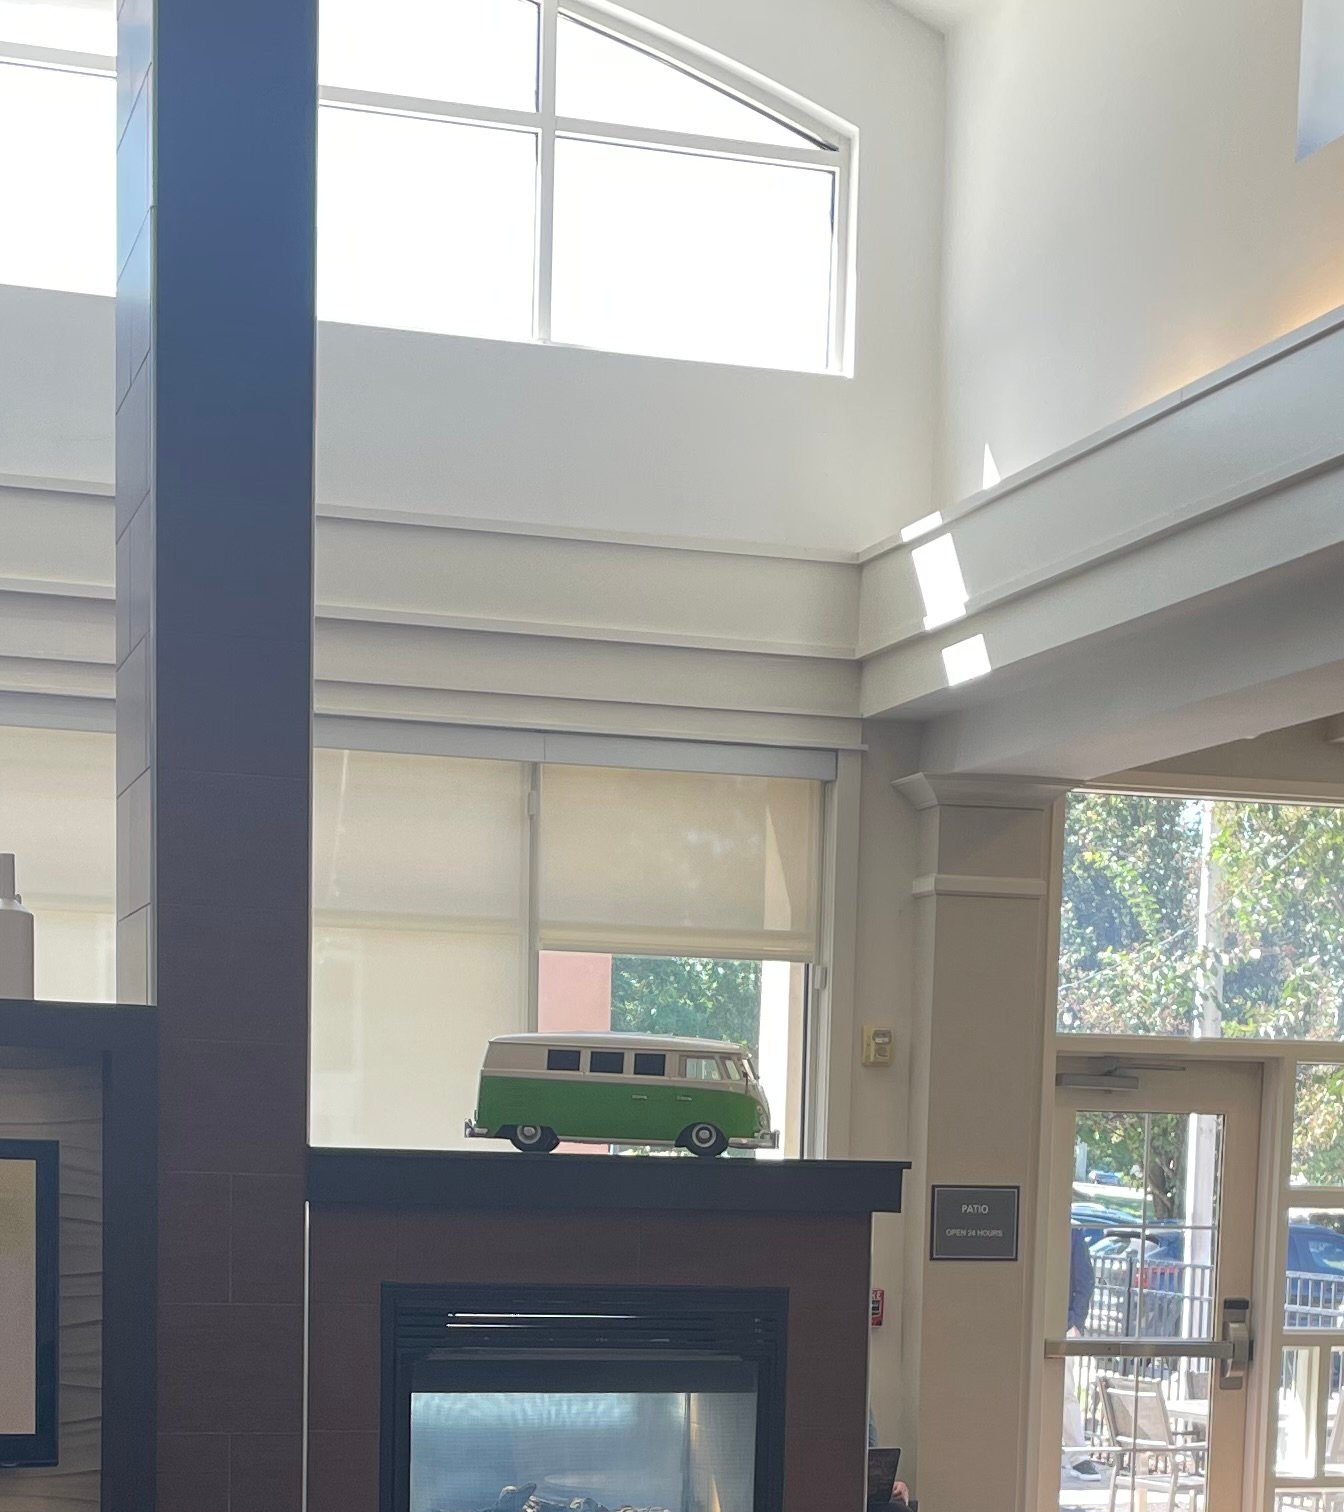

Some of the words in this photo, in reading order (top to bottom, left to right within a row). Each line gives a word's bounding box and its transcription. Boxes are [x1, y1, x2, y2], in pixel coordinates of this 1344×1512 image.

[961, 1204, 989, 1214] PATIO
[945, 1228, 967, 1237] OPEN
[977, 1229, 1003, 1237] HOURS
